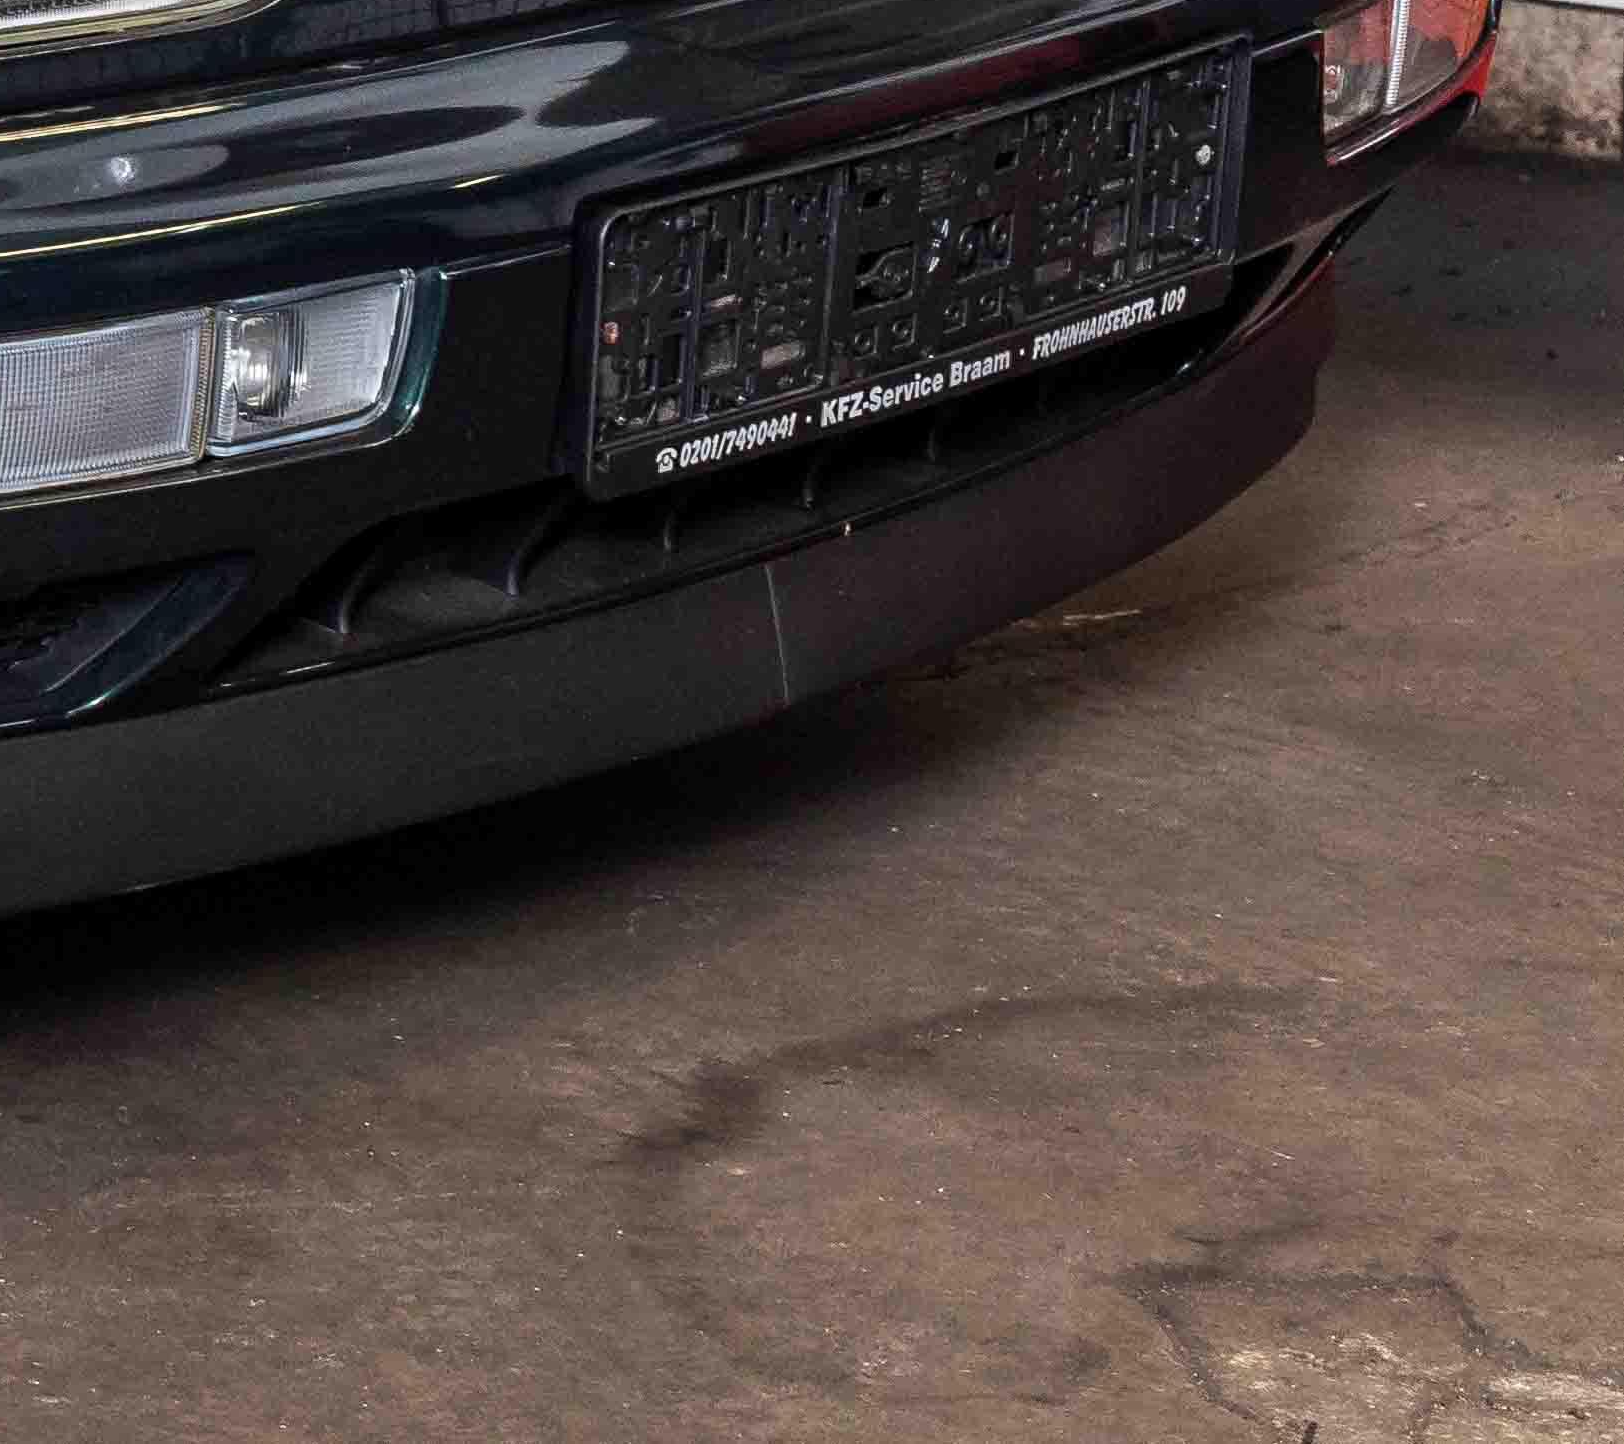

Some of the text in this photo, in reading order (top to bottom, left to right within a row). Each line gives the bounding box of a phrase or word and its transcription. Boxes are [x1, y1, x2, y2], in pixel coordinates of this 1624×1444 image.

[680, 285, 1187, 469] 0201/7490441 KFZ-Service Braam FROHNHAUSERSTR. 109
